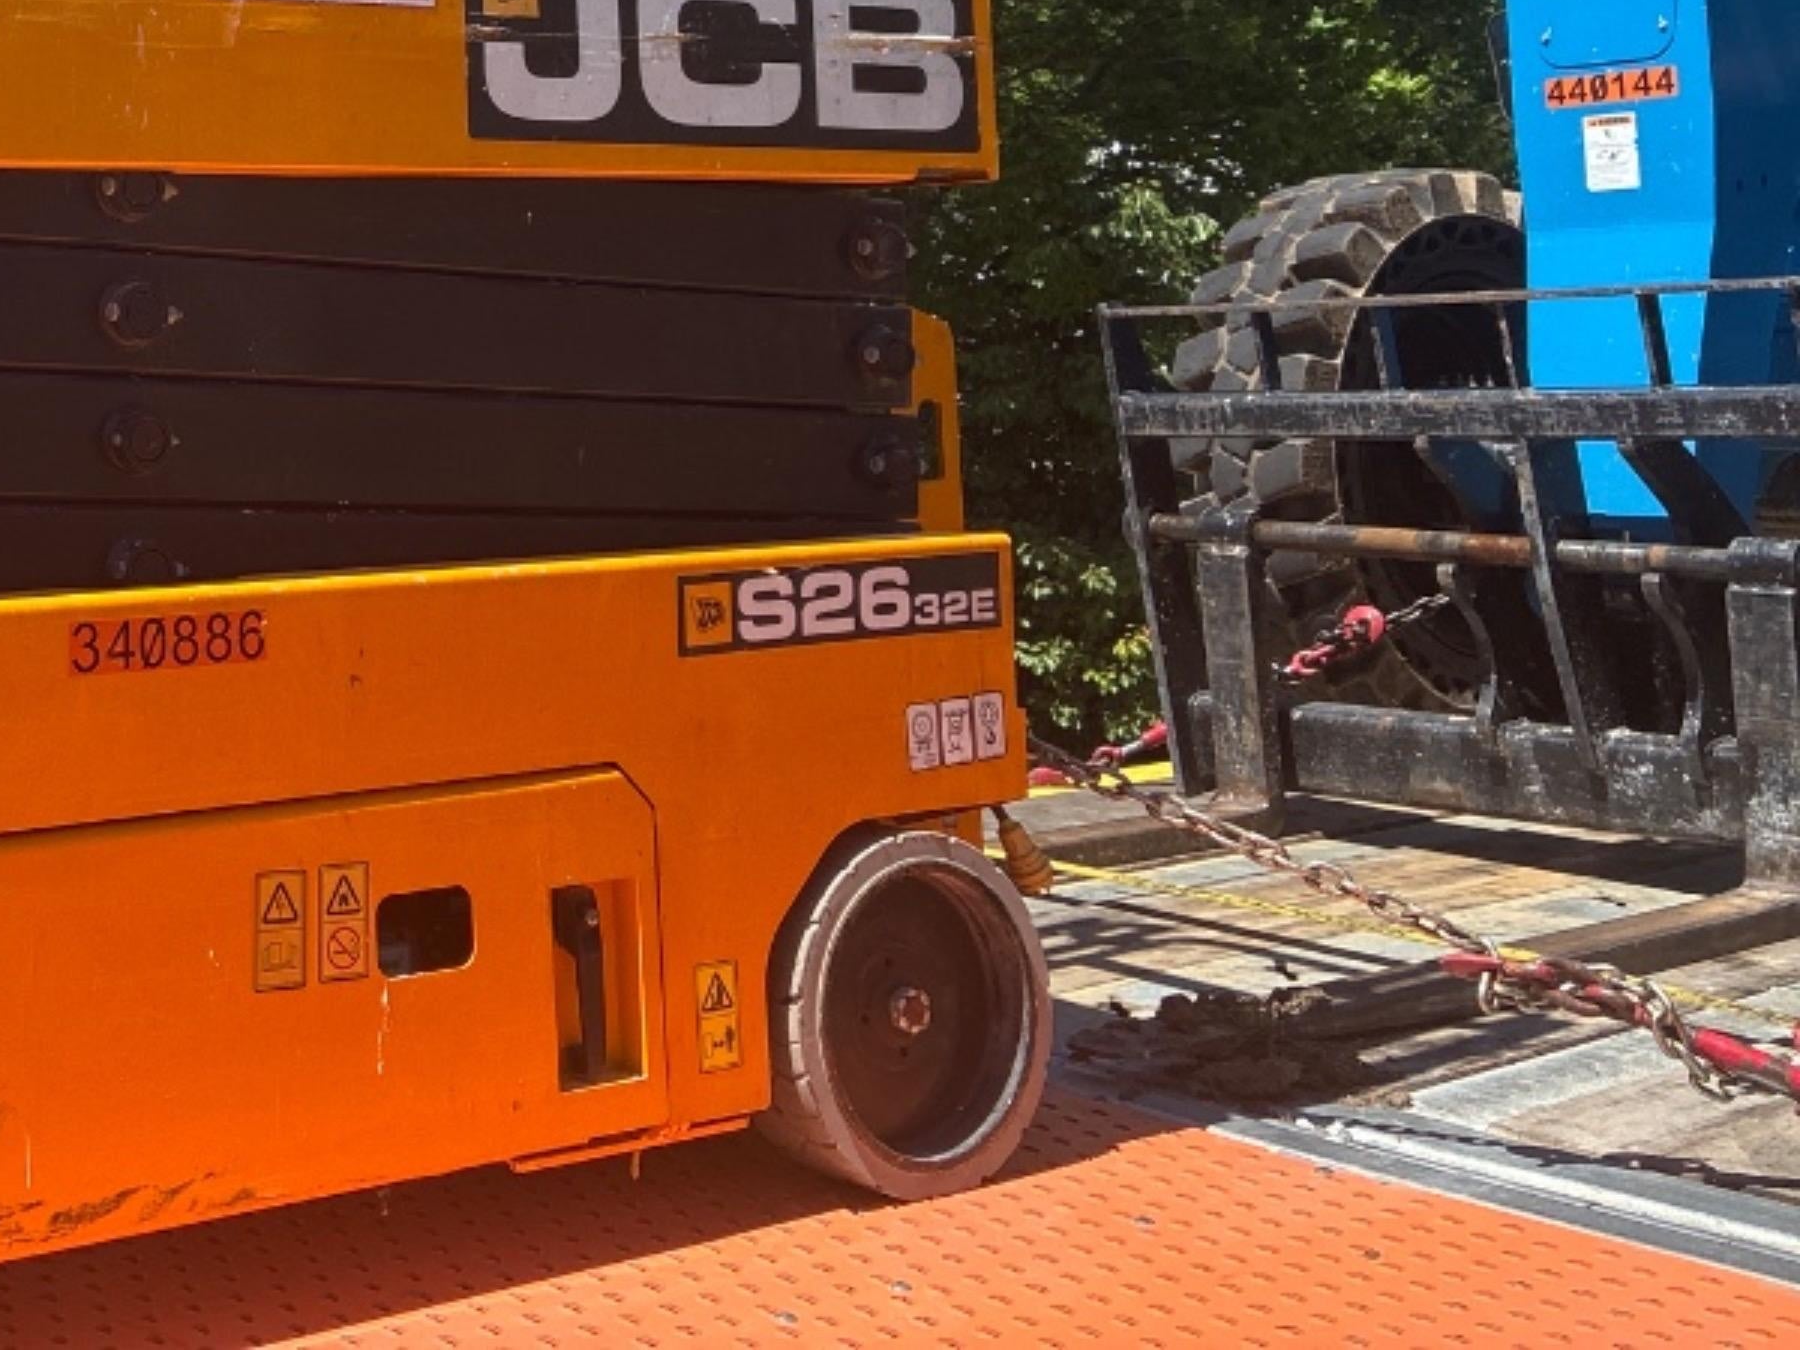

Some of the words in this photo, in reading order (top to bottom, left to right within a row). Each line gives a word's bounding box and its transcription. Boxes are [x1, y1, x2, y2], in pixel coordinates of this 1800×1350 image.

[1546, 66, 1675, 106] 440144
[737, 566, 910, 642] S26
[913, 587, 997, 626] 32E
[71, 609, 265, 674] 340886
